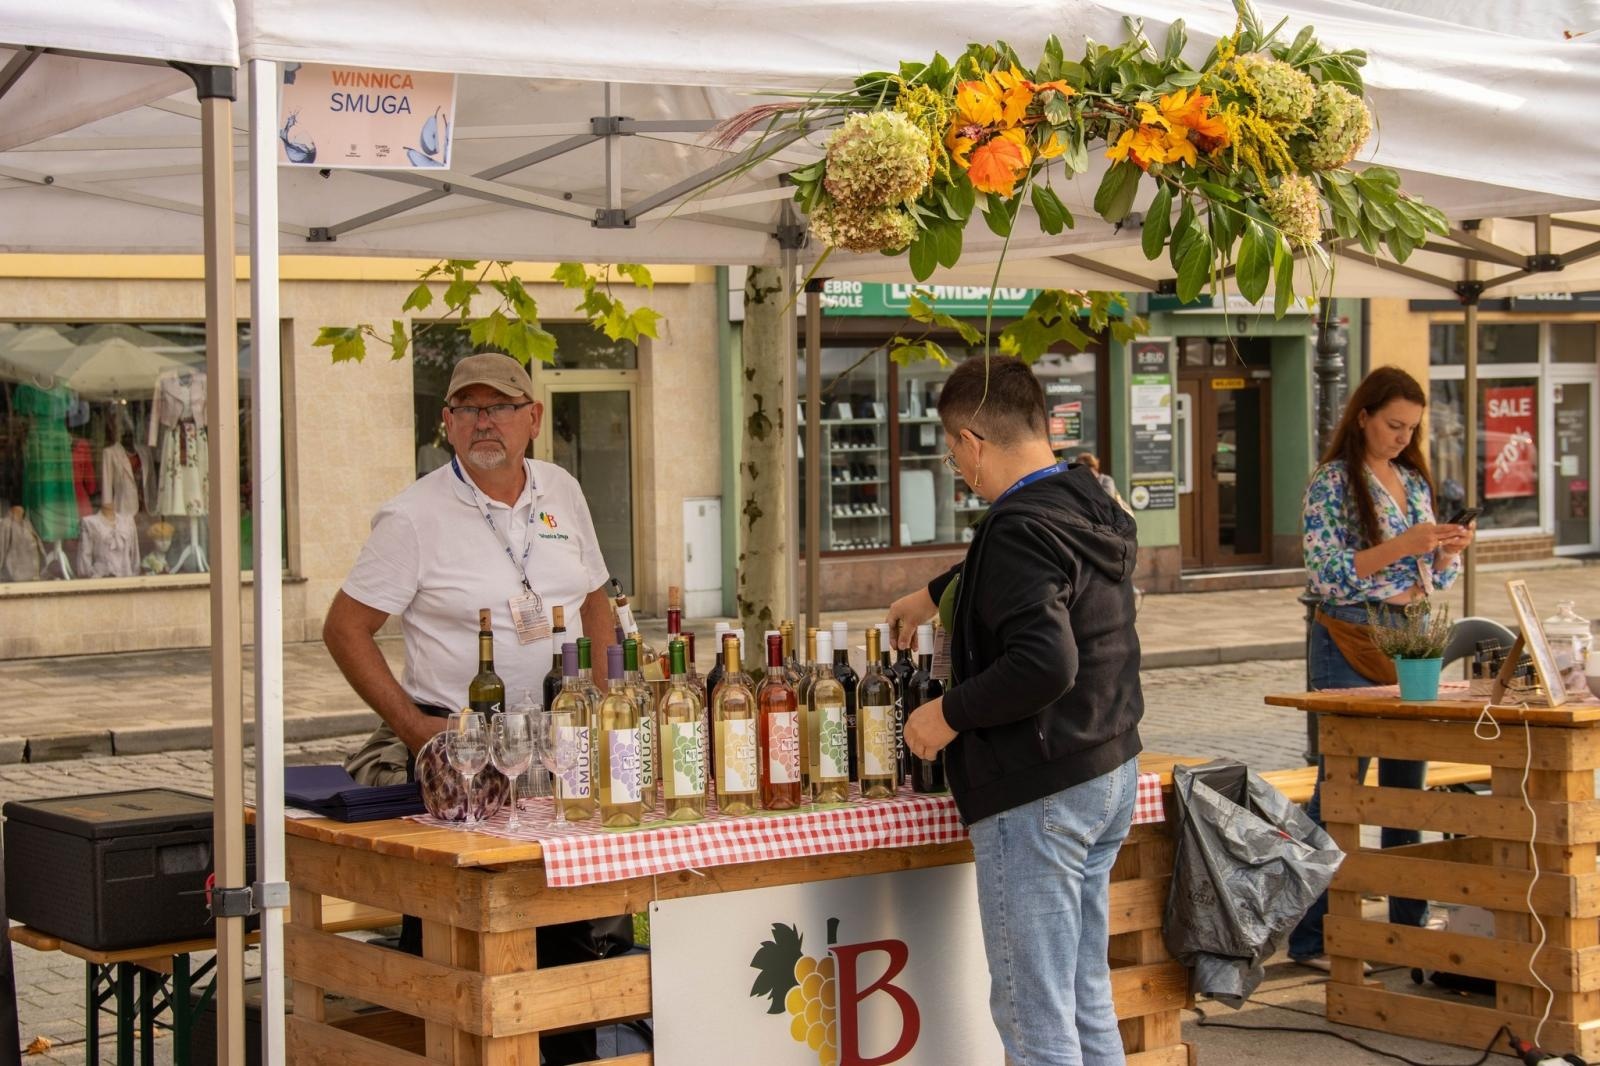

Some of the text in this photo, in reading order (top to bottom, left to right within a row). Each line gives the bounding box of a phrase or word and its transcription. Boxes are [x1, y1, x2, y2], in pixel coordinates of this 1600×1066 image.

[330, 92, 412, 115] SMUGA
[331, 70, 414, 90] WINNICA
[1237, 317, 1248, 334] 6
[1488, 398, 1531, 418] SALE
[642, 719, 652, 785] SMUGA
[886, 710, 896, 772] SMUGA
[895, 697, 904, 760] SMUGA
[579, 729, 590, 796] SMUGA
[828, 939, 921, 1066] B
